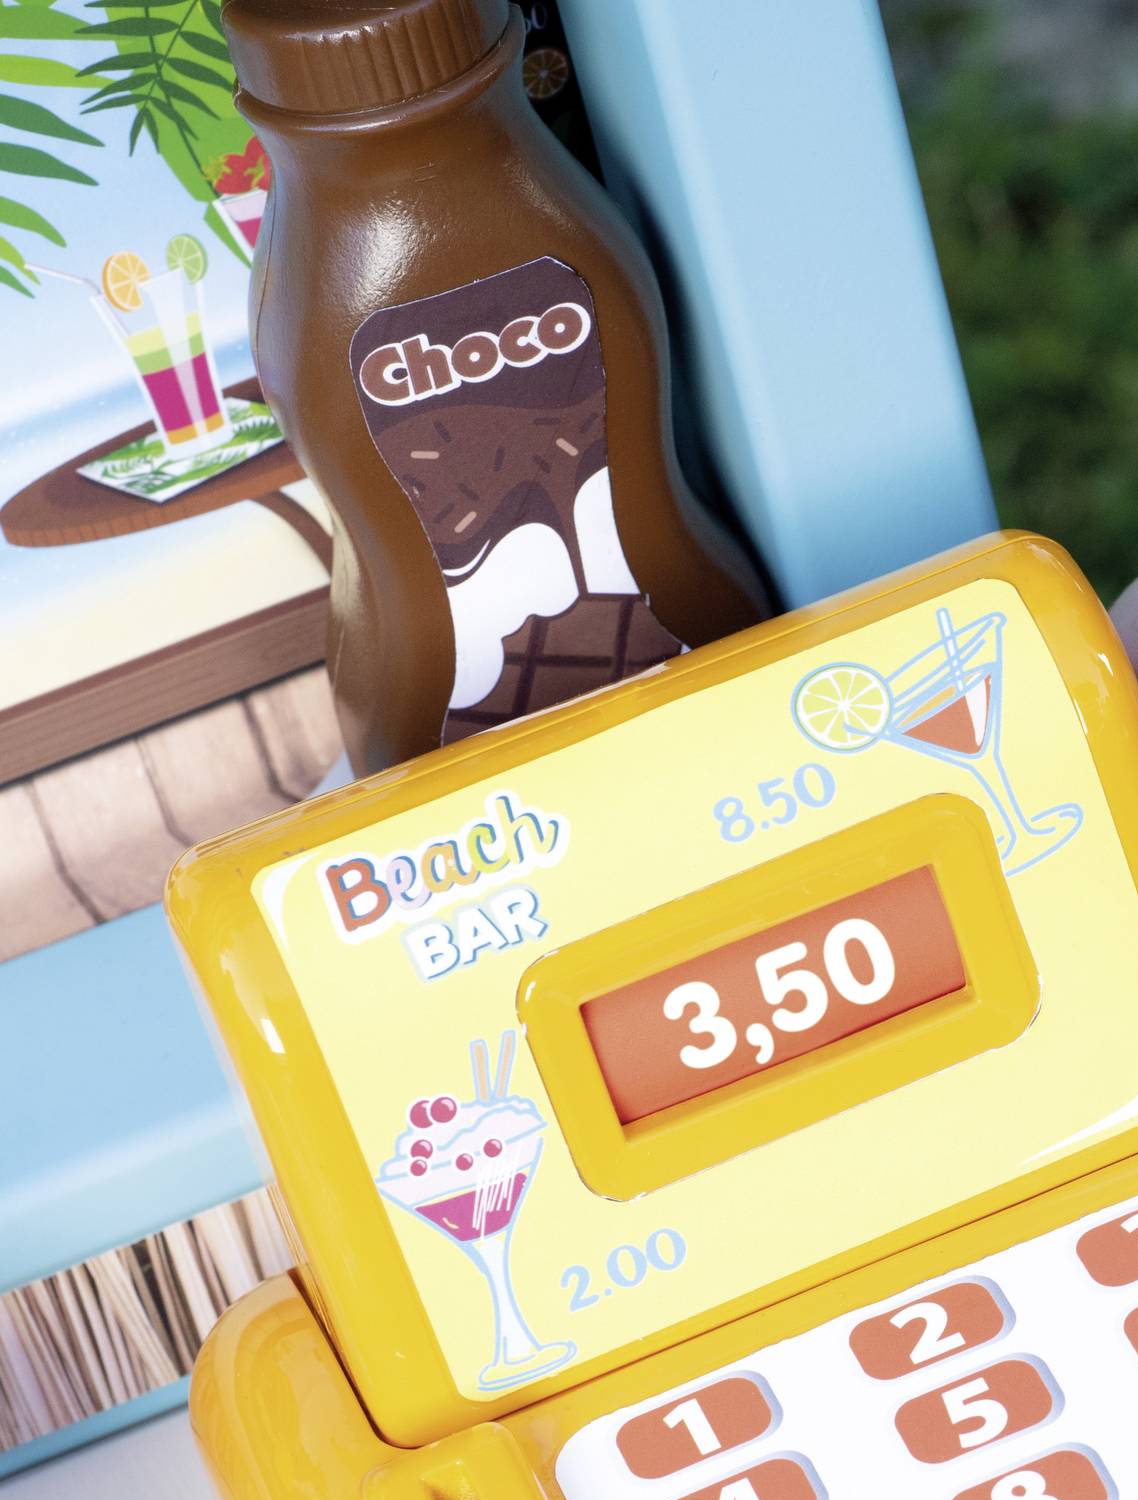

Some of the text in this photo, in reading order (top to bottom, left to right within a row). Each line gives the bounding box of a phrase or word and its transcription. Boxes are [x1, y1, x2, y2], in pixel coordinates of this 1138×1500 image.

[360, 302, 591, 406] Choco
[713, 762, 837, 843] 8.50
[325, 795, 560, 933] Beach
[405, 886, 548, 980] BAR
[663, 918, 896, 1070] 3,50
[559, 1228, 688, 1312] 2.00
[888, 1301, 967, 1365] 2
[660, 1398, 722, 1457] 1
[941, 1377, 1008, 1449] 5
